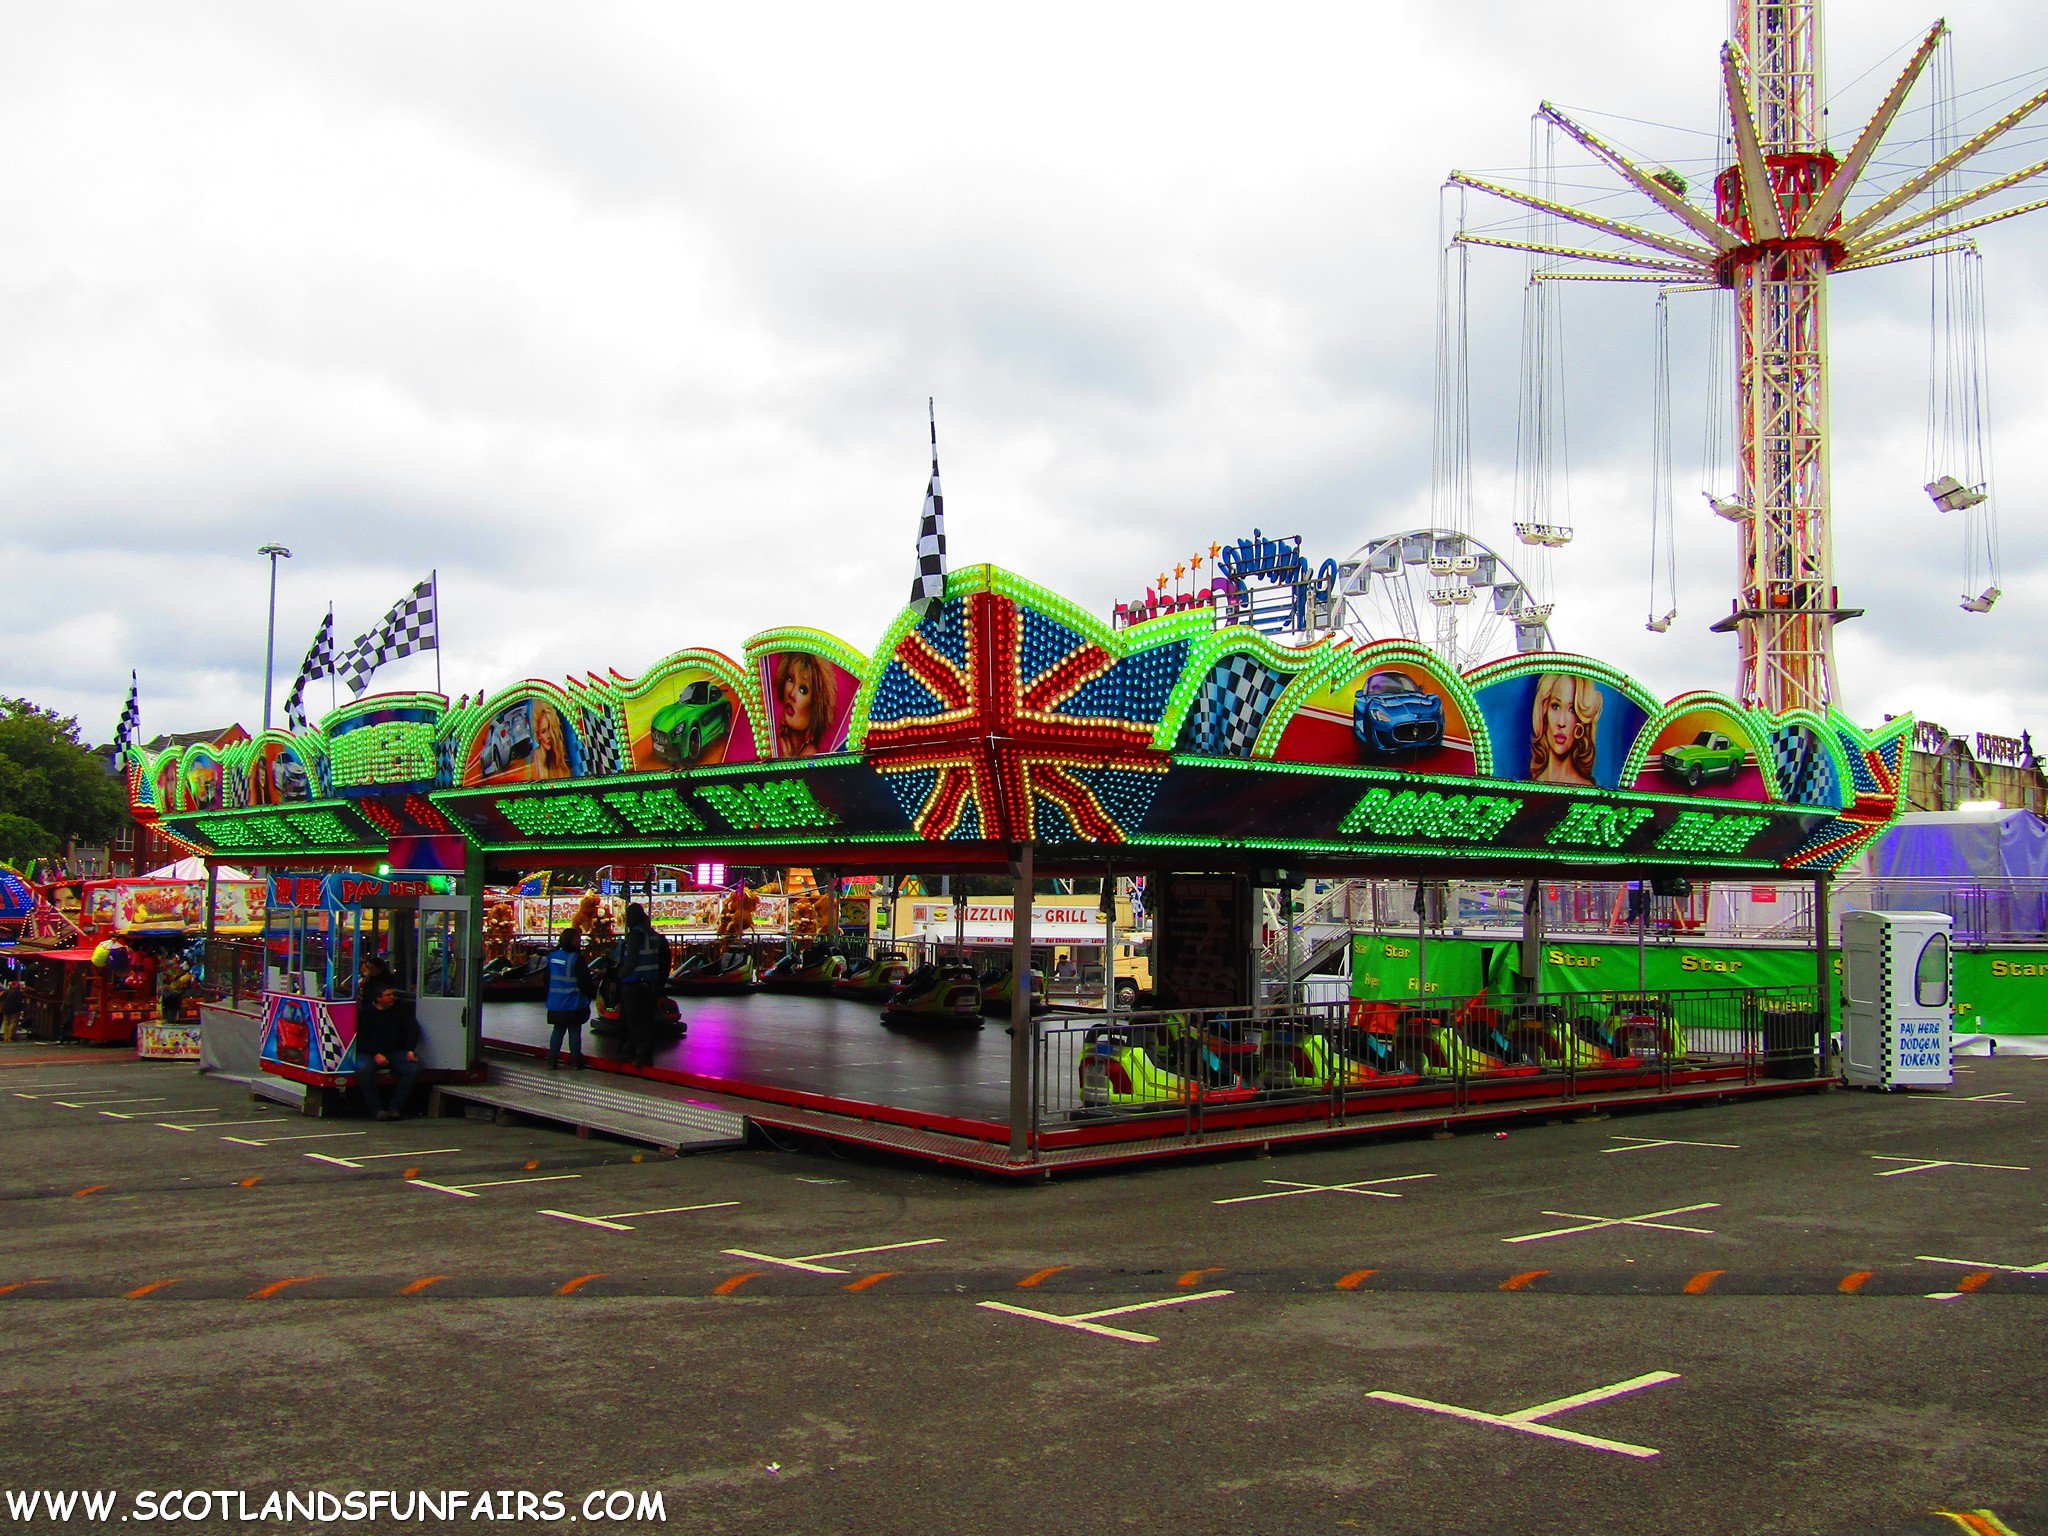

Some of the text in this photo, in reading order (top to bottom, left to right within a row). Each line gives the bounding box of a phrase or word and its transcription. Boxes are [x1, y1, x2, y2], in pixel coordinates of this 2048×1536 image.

[276, 877, 321, 906] PAY HERE
[1045, 909, 1088, 923] GRILL
[1355, 942, 1367, 954] Star
[1384, 944, 1411, 958] Star
[1548, 951, 1601, 967] Star
[1681, 955, 1742, 973] Star
[1991, 960, 2048, 977] Star
[1408, 977, 1438, 992] Fler
[1900, 1023, 1940, 1036] PAY HERE
[1900, 1038, 1940, 1052] DODGEM
[1900, 1053, 1941, 1067] TOKENS
